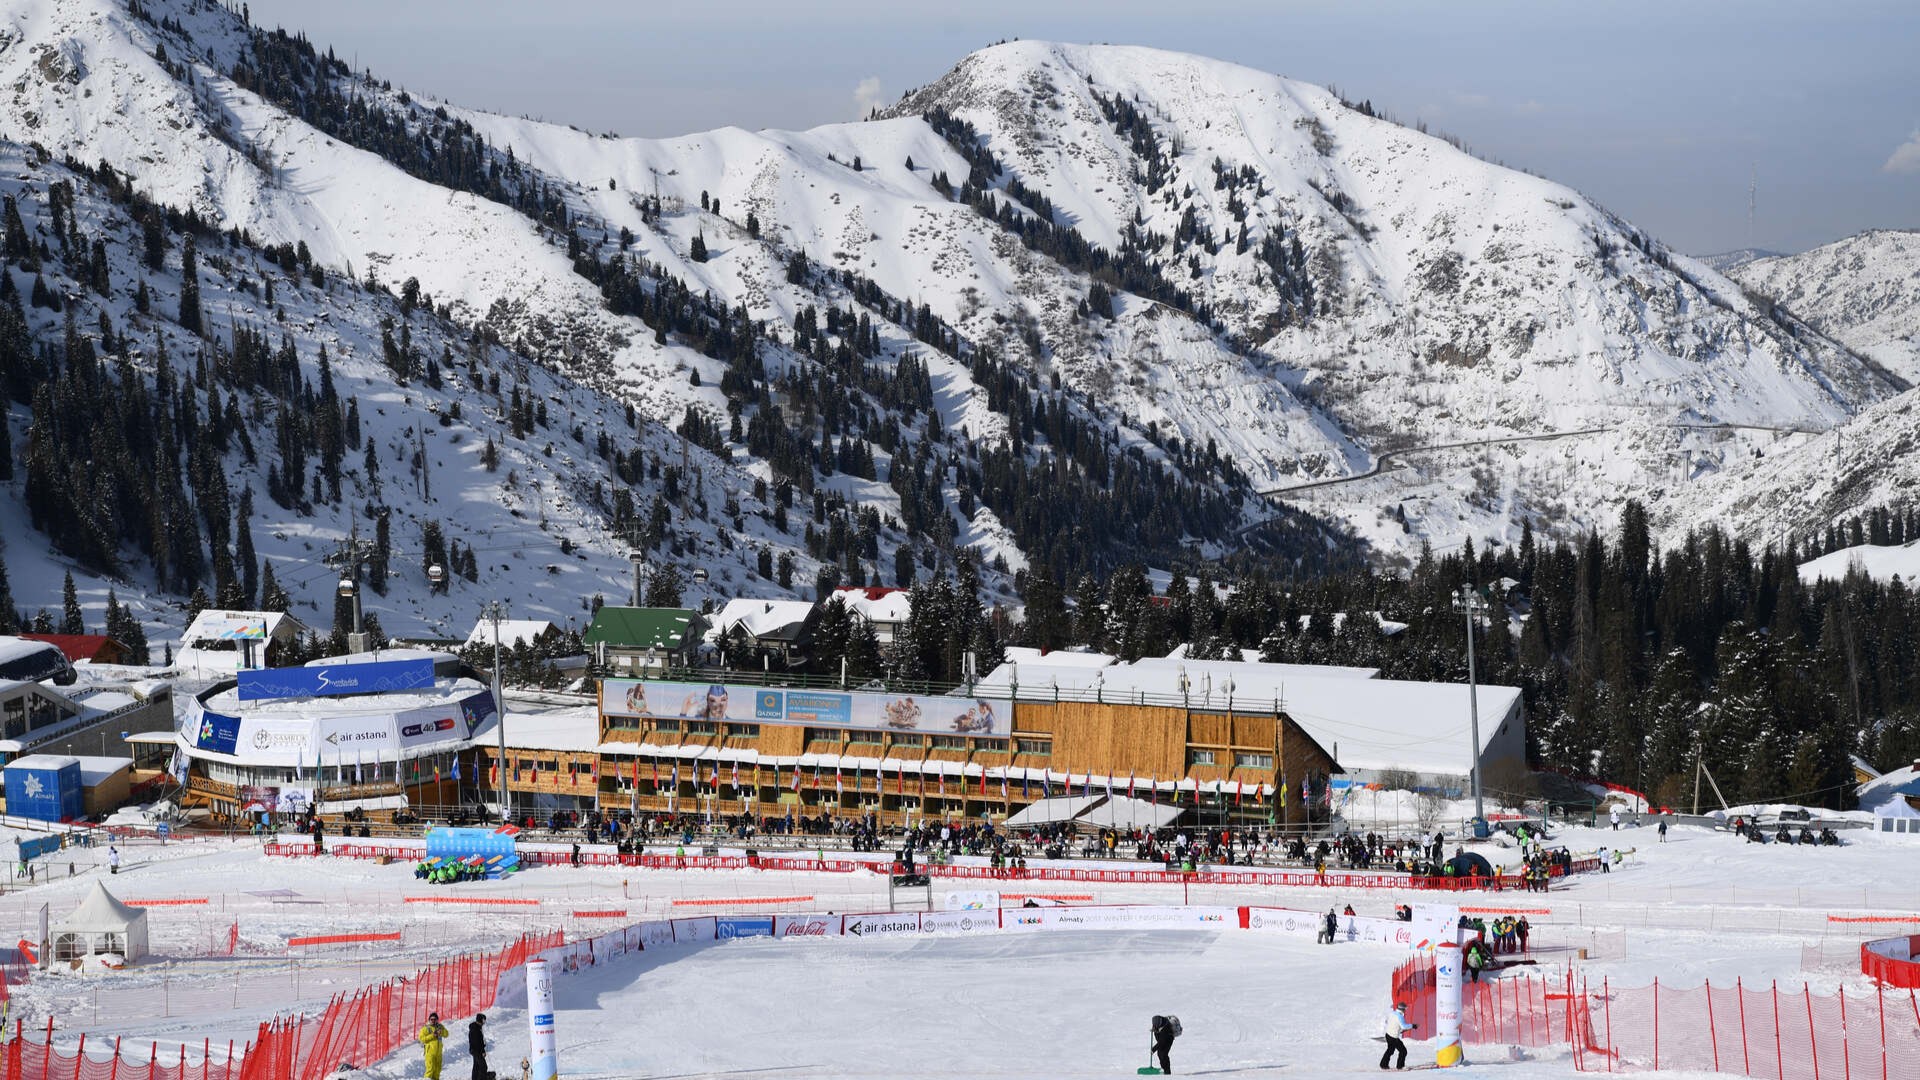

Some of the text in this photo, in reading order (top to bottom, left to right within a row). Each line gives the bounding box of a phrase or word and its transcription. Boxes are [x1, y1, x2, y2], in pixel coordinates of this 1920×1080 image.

[340, 730, 387, 742] air astana
[1058, 915, 1083, 924] Almaty
[865, 921, 916, 933] air astana
